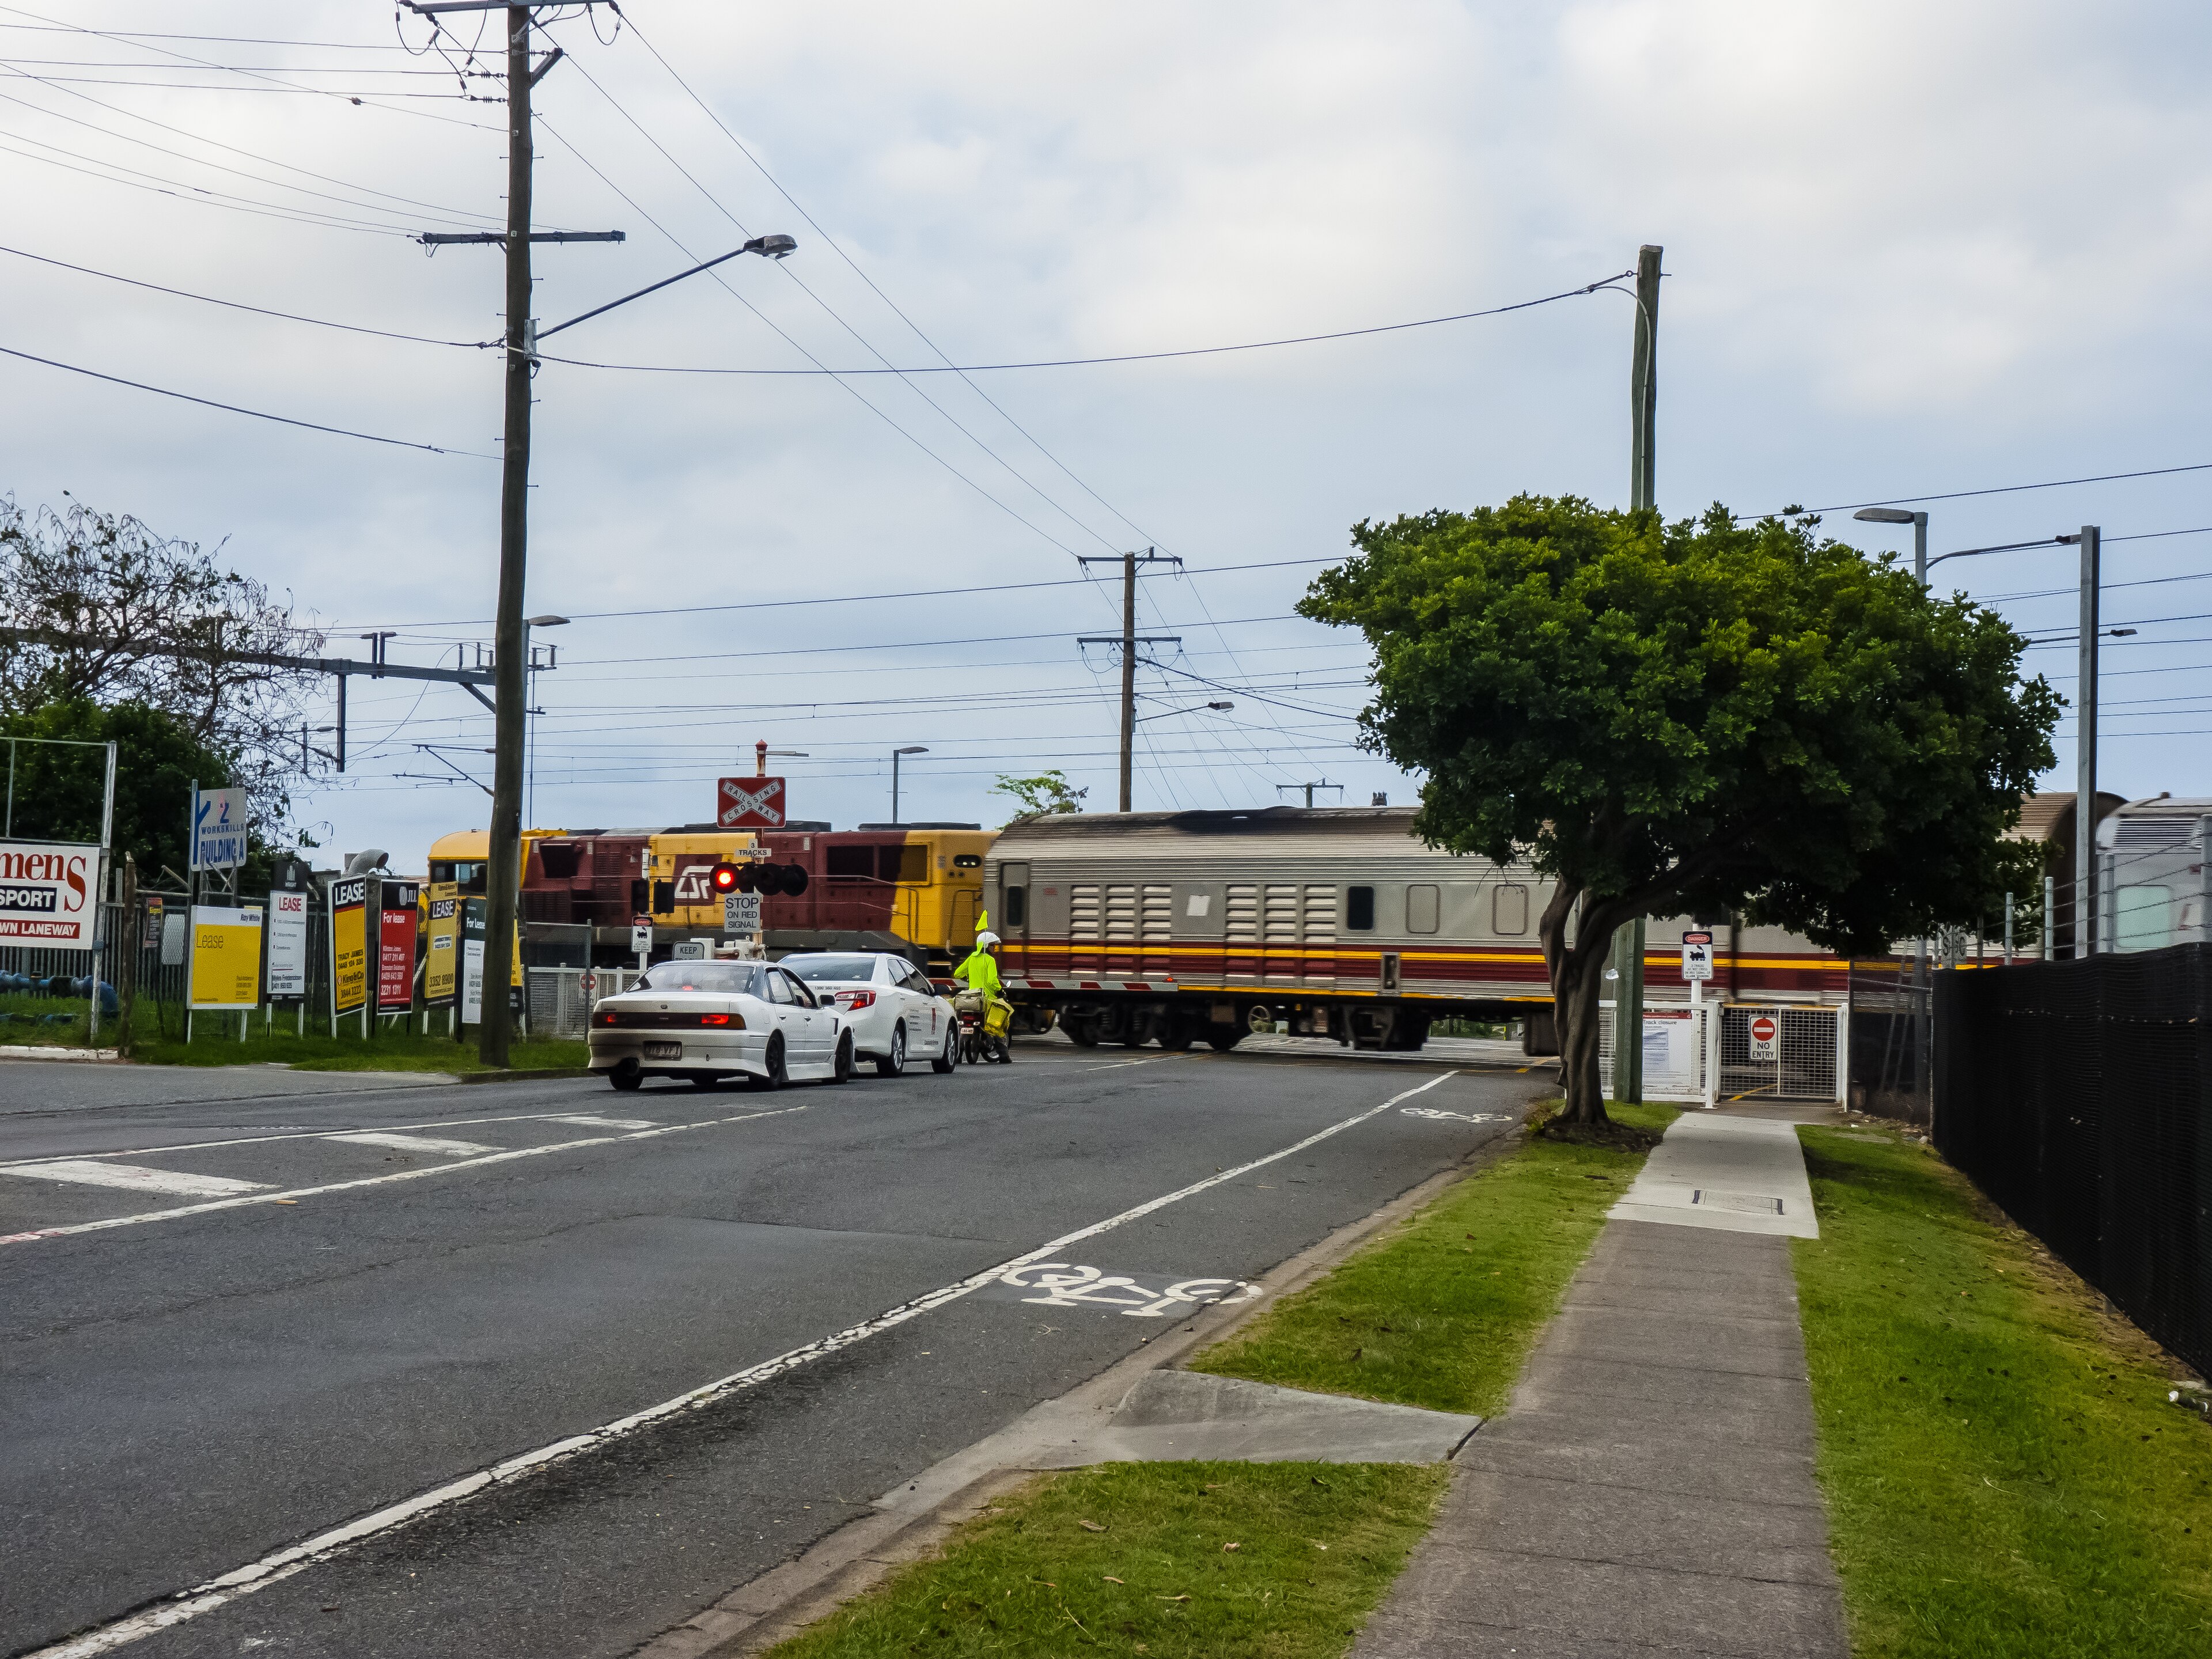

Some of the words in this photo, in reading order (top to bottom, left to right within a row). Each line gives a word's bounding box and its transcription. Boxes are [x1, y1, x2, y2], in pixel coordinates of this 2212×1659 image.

[728, 785, 776, 820] CROSSING
[201, 824, 244, 834] WORKSKILLS
[239, 837, 244, 860] A
[335, 882, 364, 906] LEASE
[407, 890, 417, 902] JLL
[279, 896, 302, 911] LEASE
[433, 900, 453, 918] LEASE
[726, 897, 759, 908] STOP
[383, 912, 392, 923] For
[393, 913, 406, 923] lease
[21, 923, 77, 936] LANEWAY
[196, 930, 224, 948] Lease
[338, 952, 350, 961] TRACY
